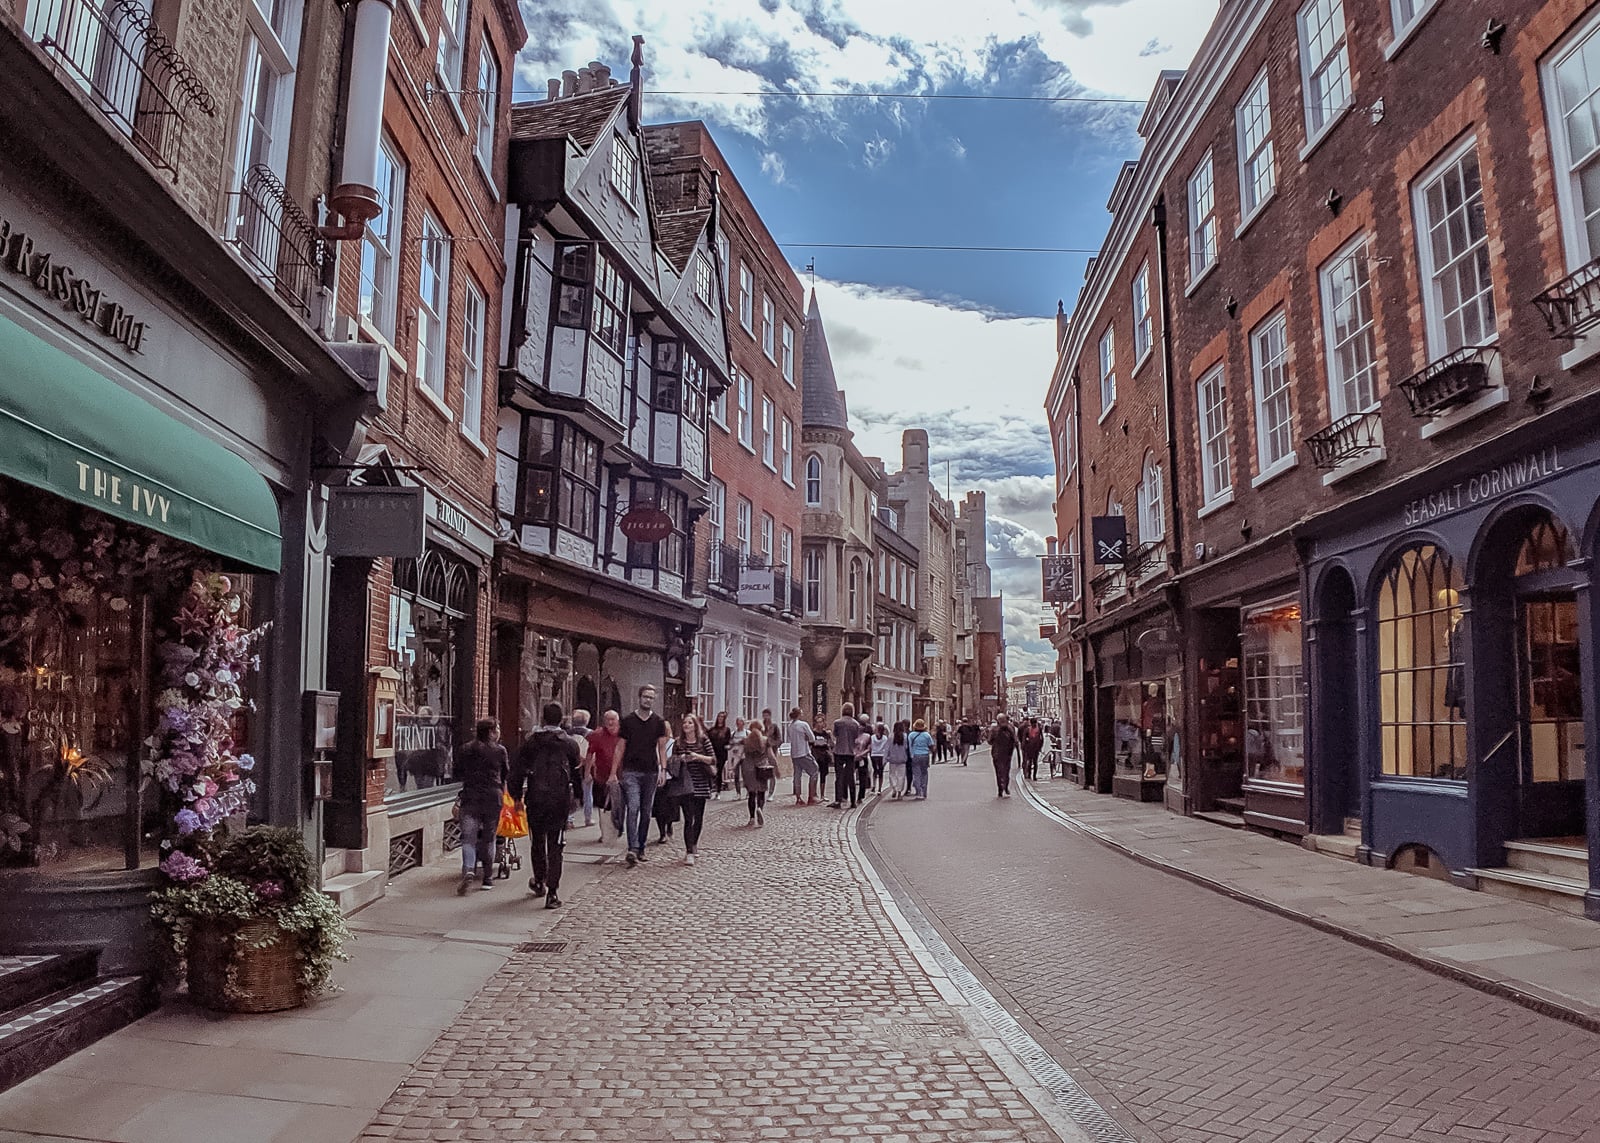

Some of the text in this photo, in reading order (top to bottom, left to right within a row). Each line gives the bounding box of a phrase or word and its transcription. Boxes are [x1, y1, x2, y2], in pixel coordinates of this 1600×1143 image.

[76, 460, 170, 523] THE IVY
[1405, 445, 1564, 526] SEASALT CORNWALL
[438, 500, 469, 537] TRINITY
[627, 522, 666, 530] JIGSAW
[396, 724, 437, 751] TRINITY
